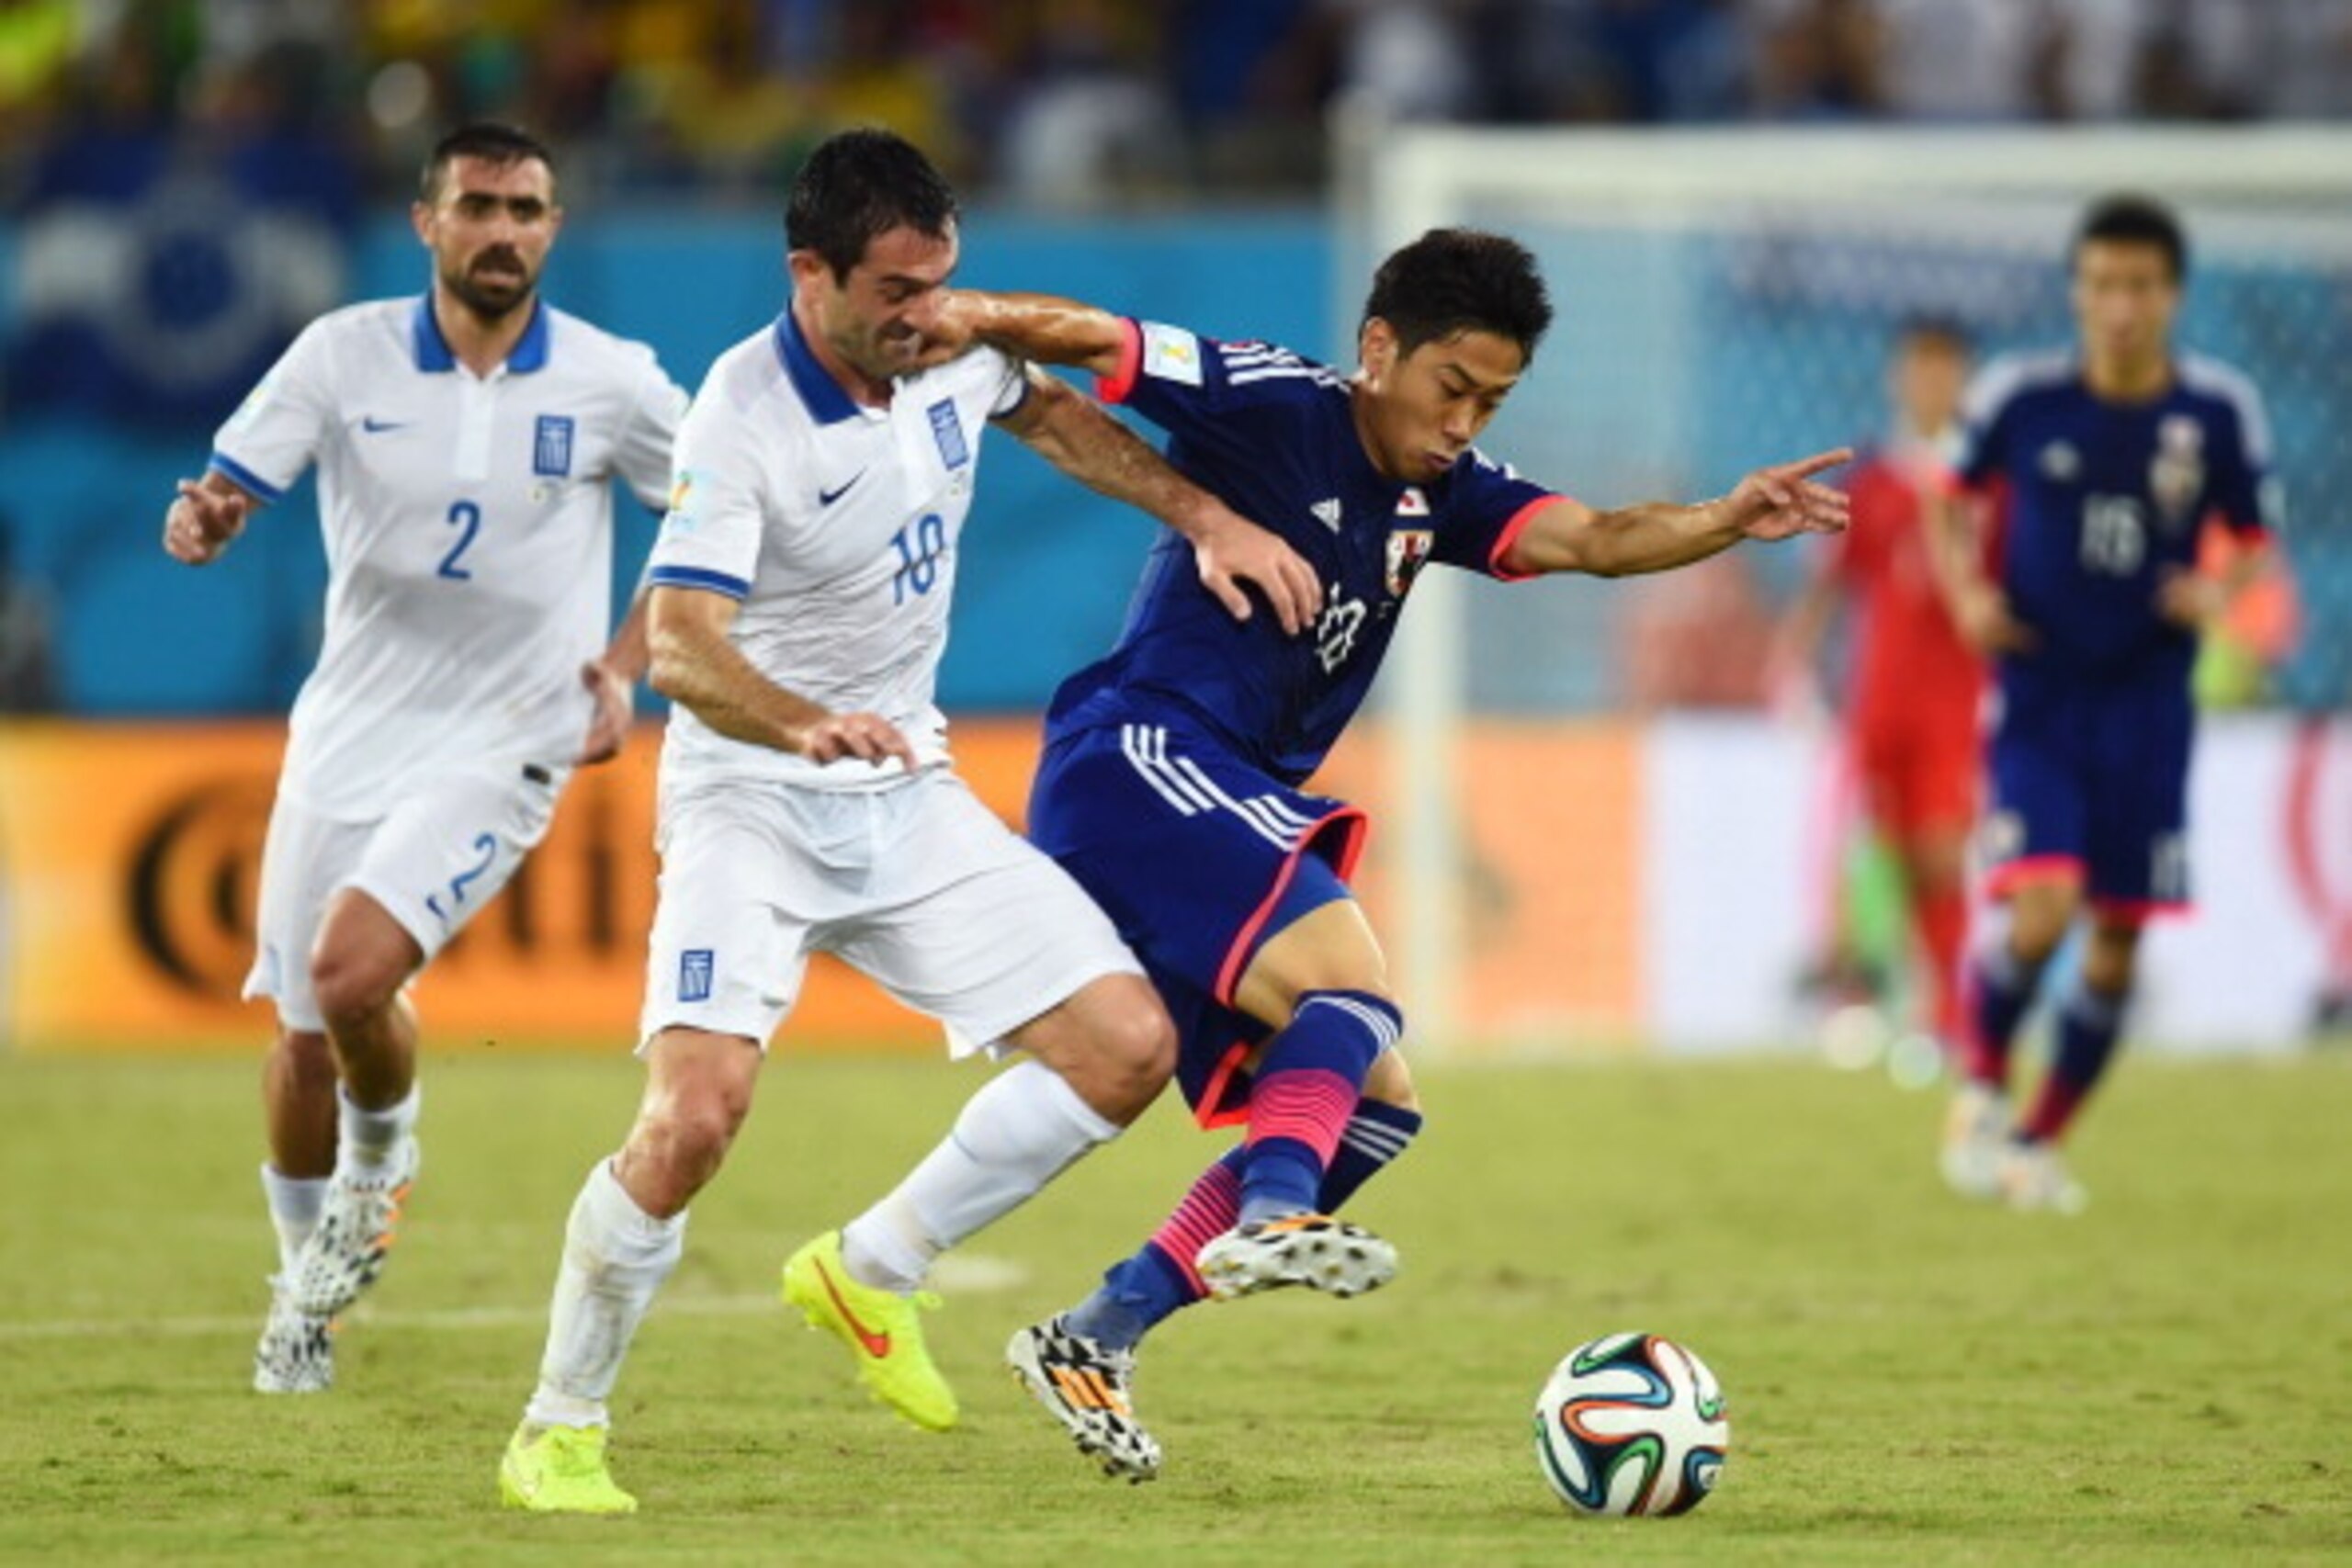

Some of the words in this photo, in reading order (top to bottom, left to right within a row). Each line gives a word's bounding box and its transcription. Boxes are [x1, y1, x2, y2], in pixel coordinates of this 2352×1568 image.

[438, 500, 481, 579] 2
[888, 513, 944, 606] 10
[449, 832, 497, 904] 2
